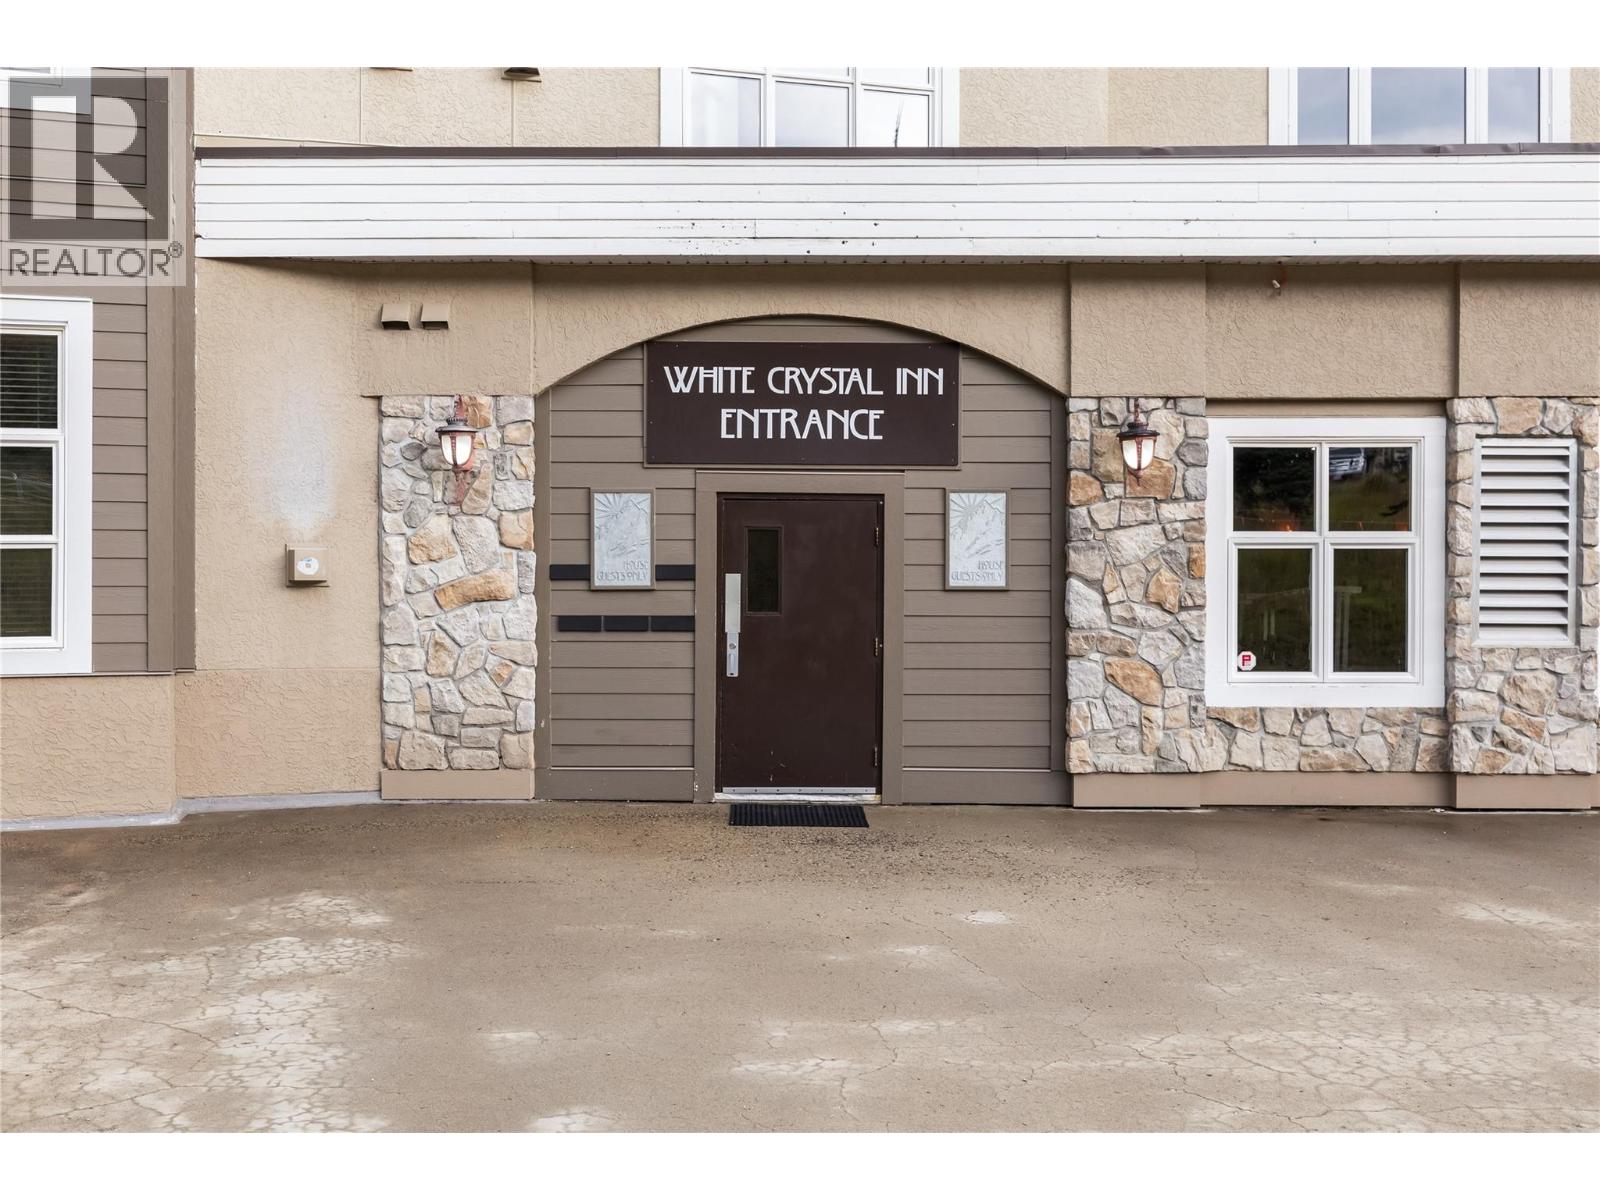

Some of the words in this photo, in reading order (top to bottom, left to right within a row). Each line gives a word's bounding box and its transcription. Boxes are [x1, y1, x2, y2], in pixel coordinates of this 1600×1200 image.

[663, 366, 755, 394] WHITE
[767, 366, 884, 395] CRYSTAL
[896, 367, 944, 395] INN
[720, 408, 885, 440] ENTRANCE
